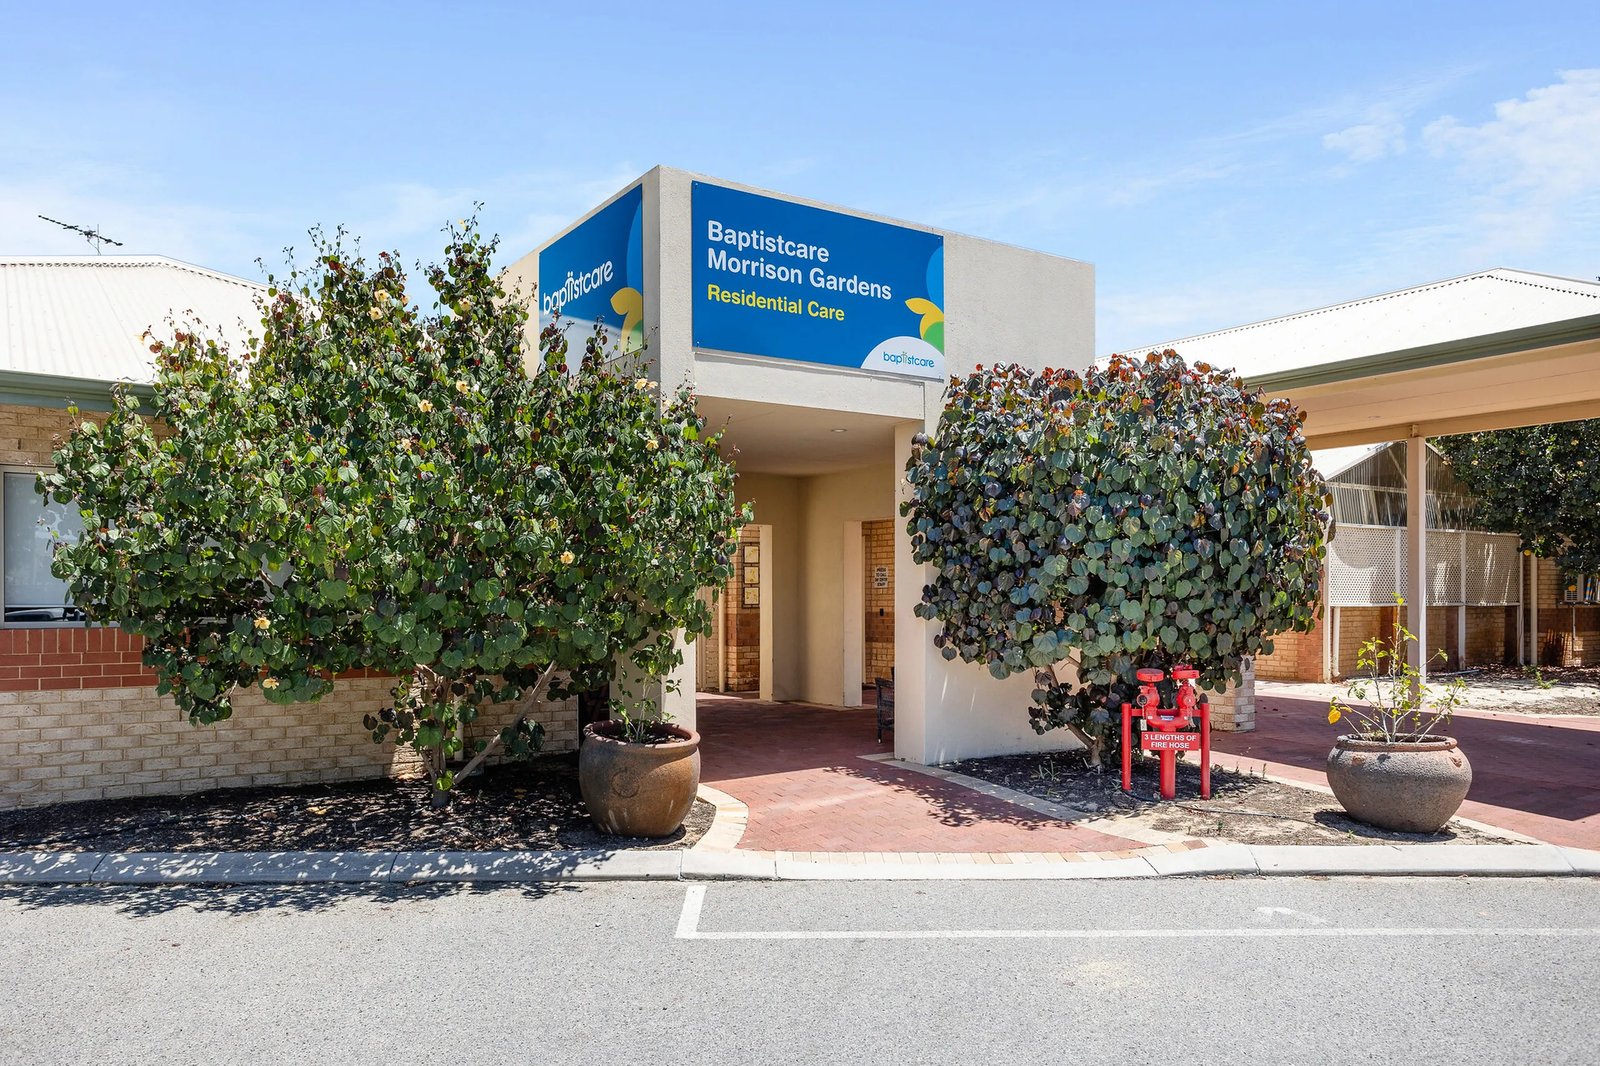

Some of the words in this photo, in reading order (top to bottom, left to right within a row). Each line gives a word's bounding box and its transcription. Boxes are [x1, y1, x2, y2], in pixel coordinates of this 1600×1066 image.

[707, 220, 830, 263] Baptistcare
[707, 248, 802, 285] Morrison
[809, 268, 892, 300] Gardens
[707, 284, 802, 315] Residential
[807, 301, 845, 321] Care
